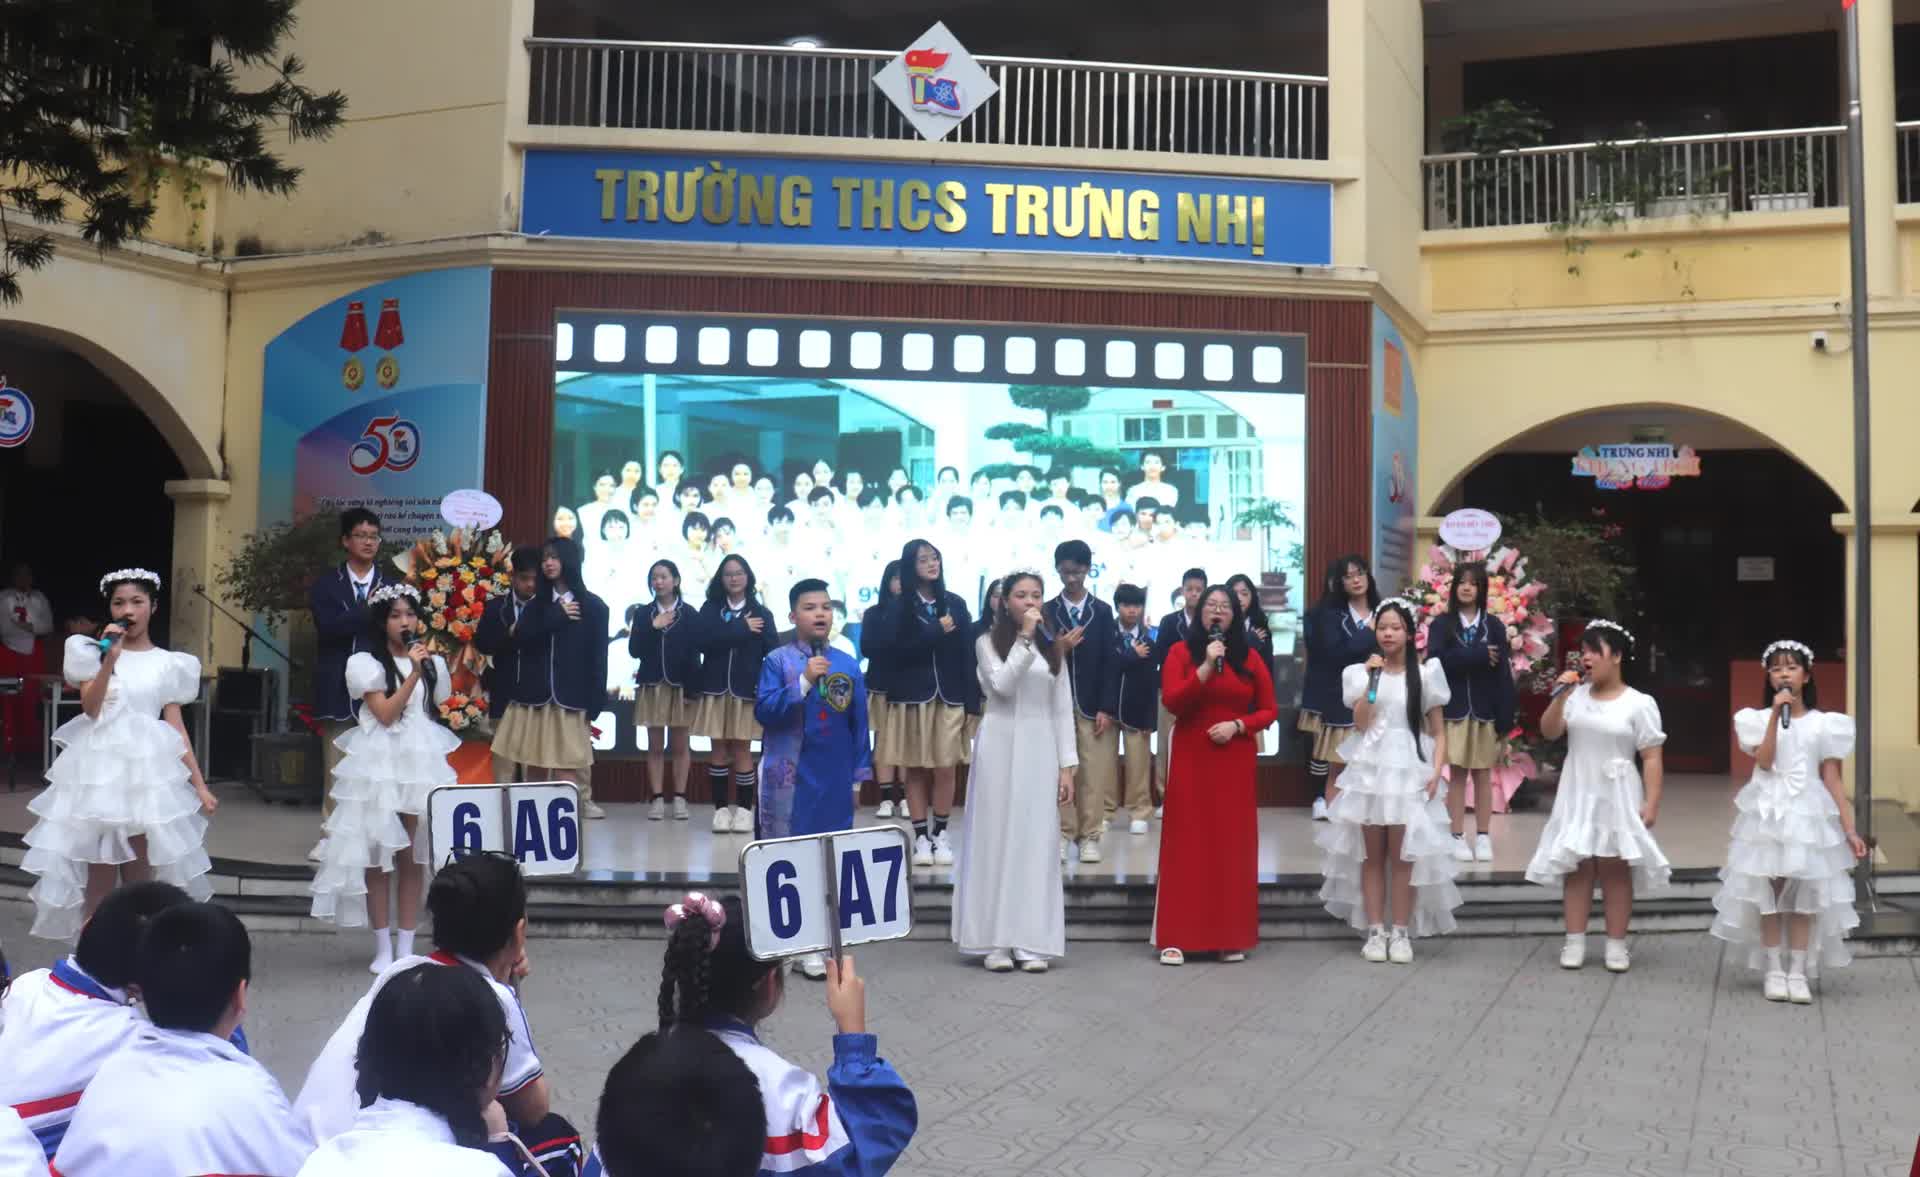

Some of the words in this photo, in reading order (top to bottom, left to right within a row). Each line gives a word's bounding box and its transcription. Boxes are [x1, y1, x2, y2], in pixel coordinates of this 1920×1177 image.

[595, 160, 813, 227] TRƯỜNG
[832, 177, 967, 233] THCS
[985, 182, 1160, 241] TRƯNG
[1177, 192, 1265, 256] NHỊ
[453, 802, 482, 865] 6
[514, 797, 578, 863] A6
[766, 860, 802, 939] 6
[839, 844, 903, 929] A7
